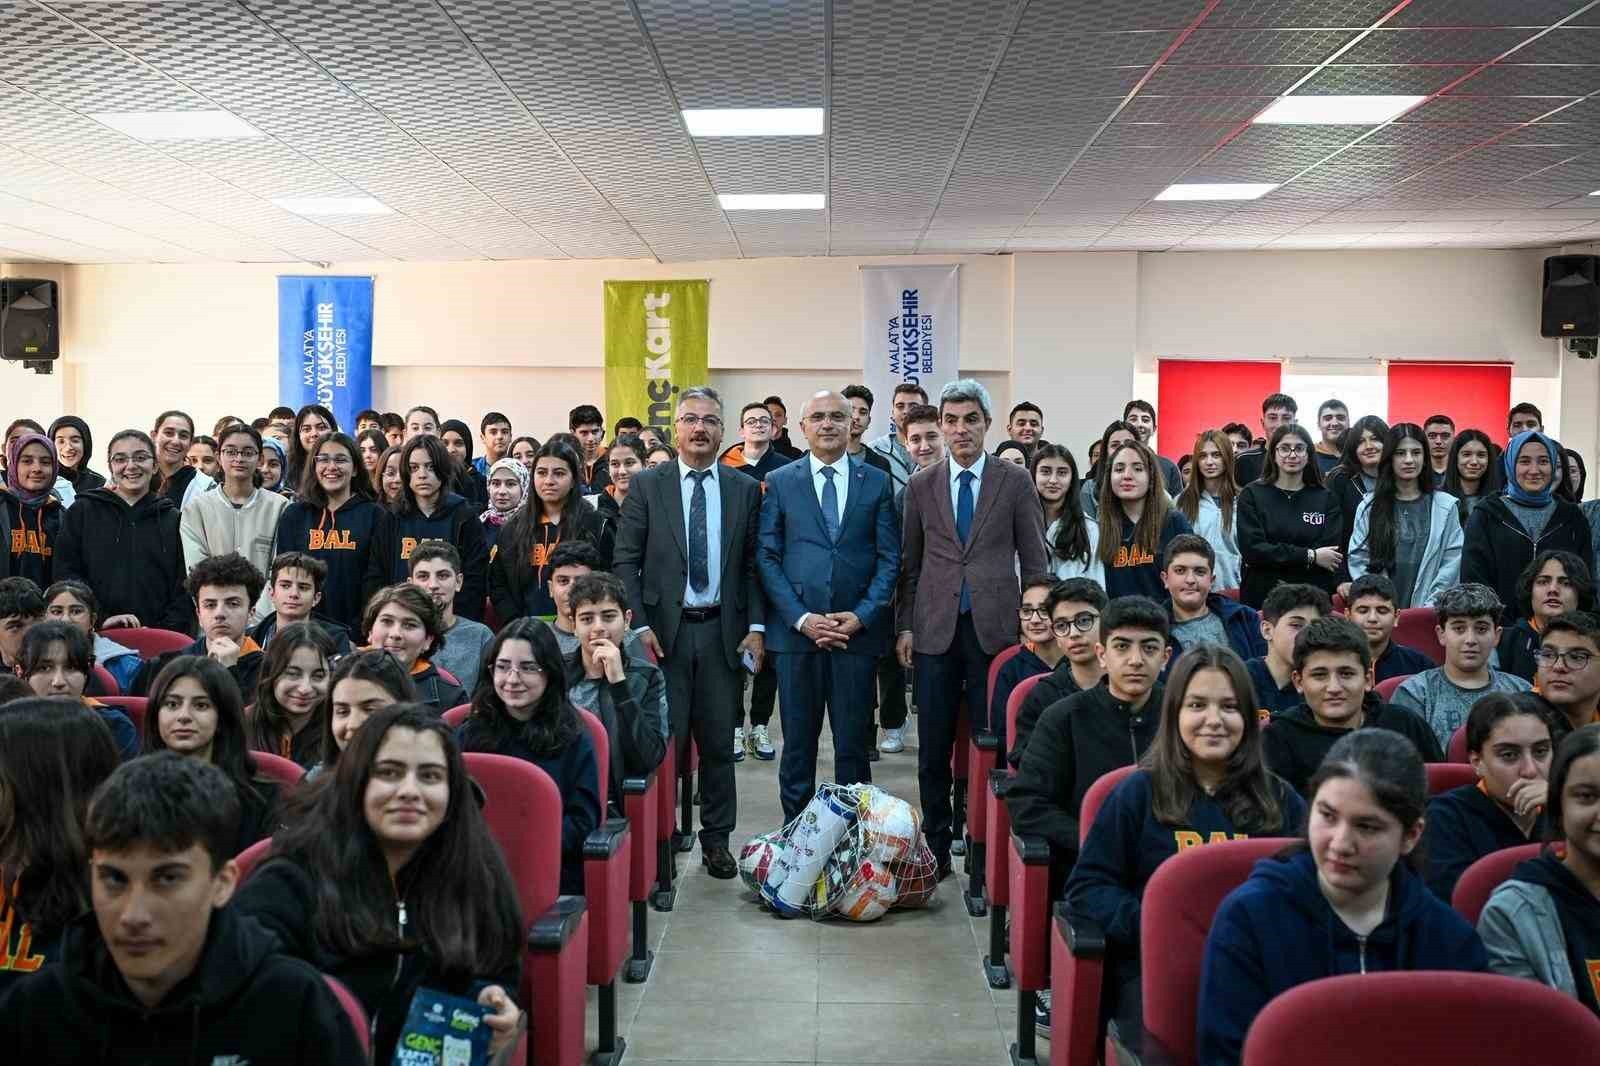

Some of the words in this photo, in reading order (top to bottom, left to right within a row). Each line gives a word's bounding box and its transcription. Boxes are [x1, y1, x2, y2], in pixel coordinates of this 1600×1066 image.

[304, 329, 314, 386] MALATYA
[888, 316, 900, 374] MALATYA
[902, 288, 921, 386] ÜYÜKŞEHİR
[921, 314, 933, 374] BELEDİYESİ
[11, 528, 52, 556] BAL
[308, 528, 356, 550] BAL
[1112, 543, 1154, 568] BAL
